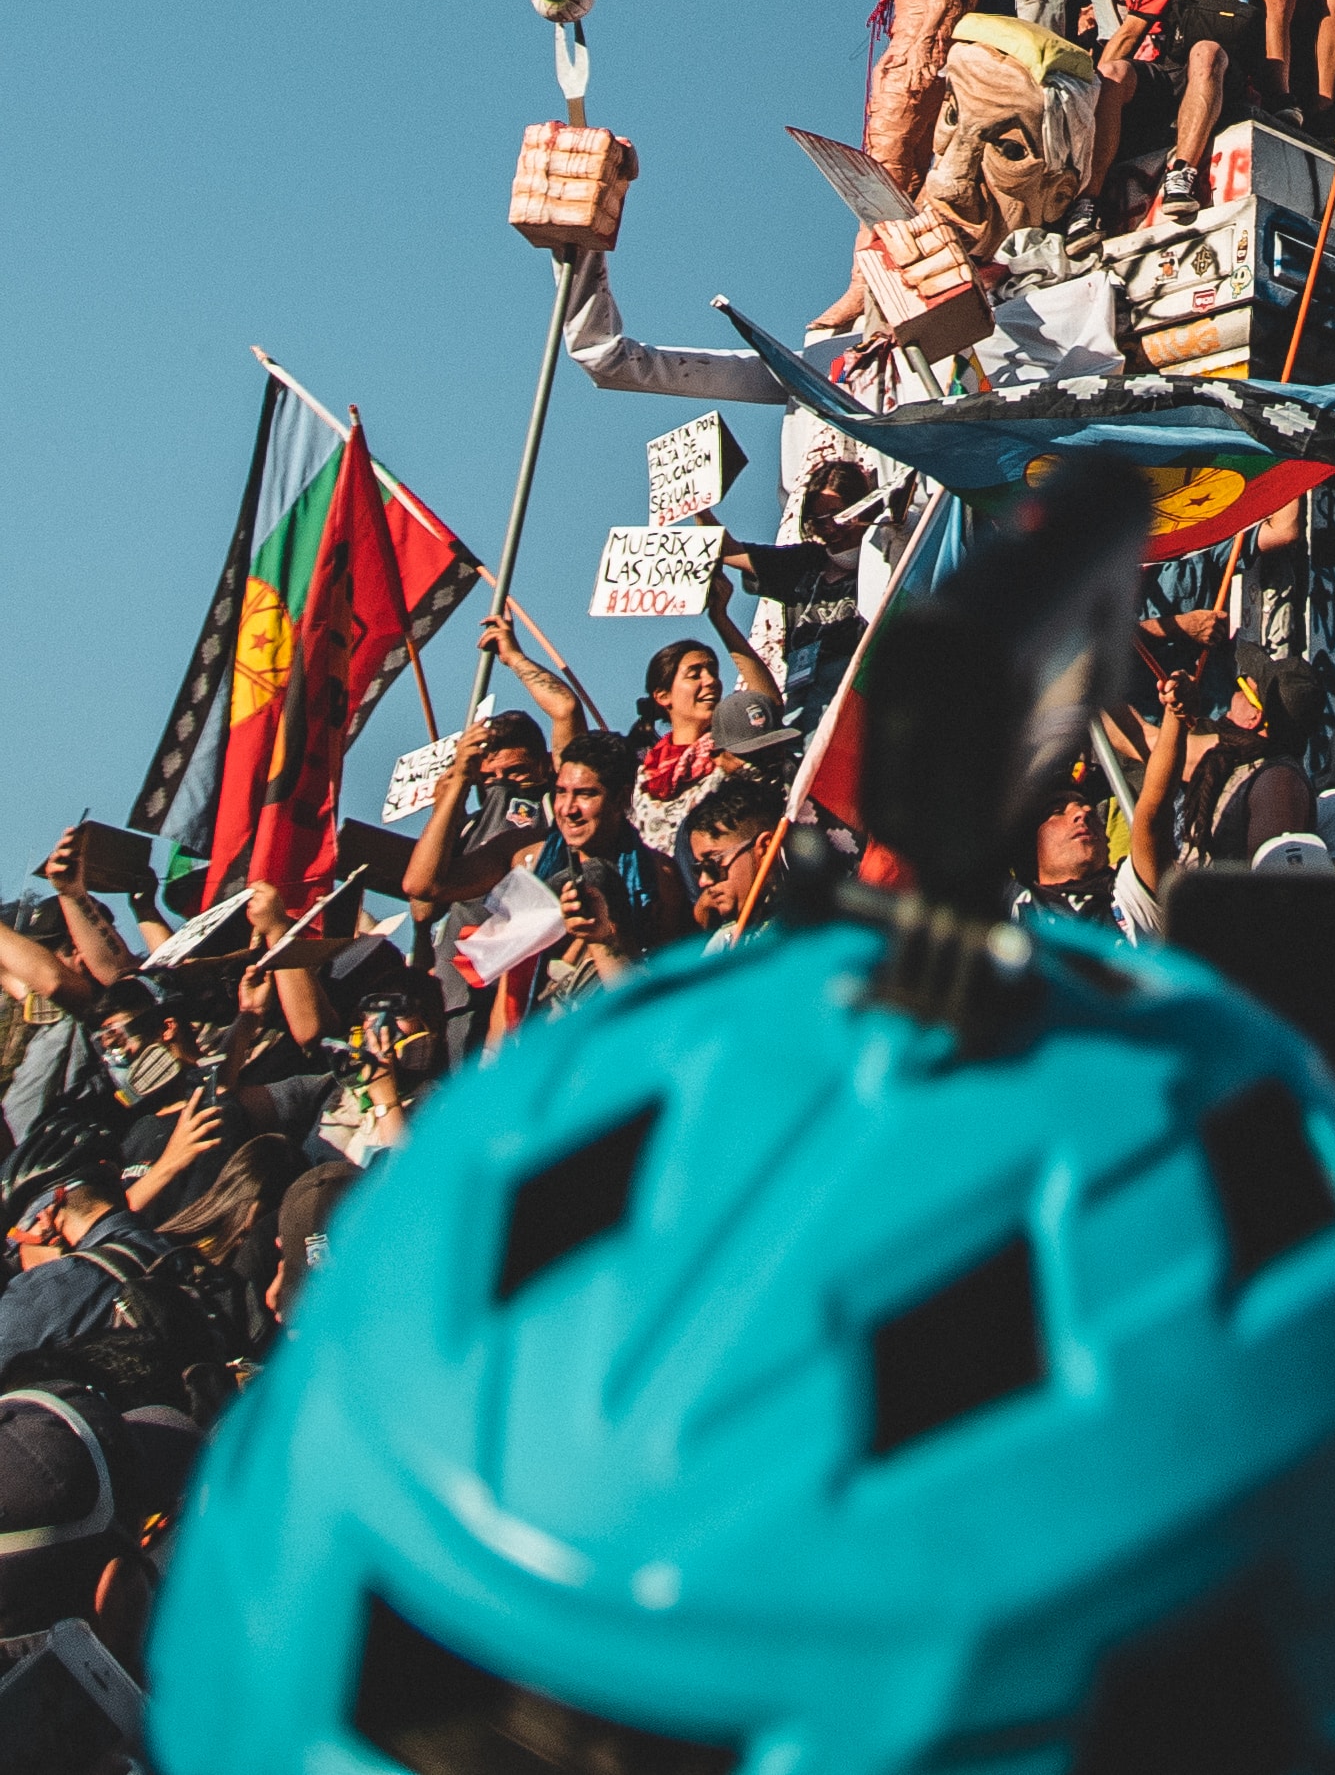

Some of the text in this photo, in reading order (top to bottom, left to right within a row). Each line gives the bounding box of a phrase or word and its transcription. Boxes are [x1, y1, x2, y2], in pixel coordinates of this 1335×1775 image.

[696, 415, 716, 433] POR
[649, 438, 697, 468] FALTA DE
[650, 478, 699, 514] SEXUAL
[608, 531, 718, 558] MUERTX X
[604, 557, 644, 587] LAS
